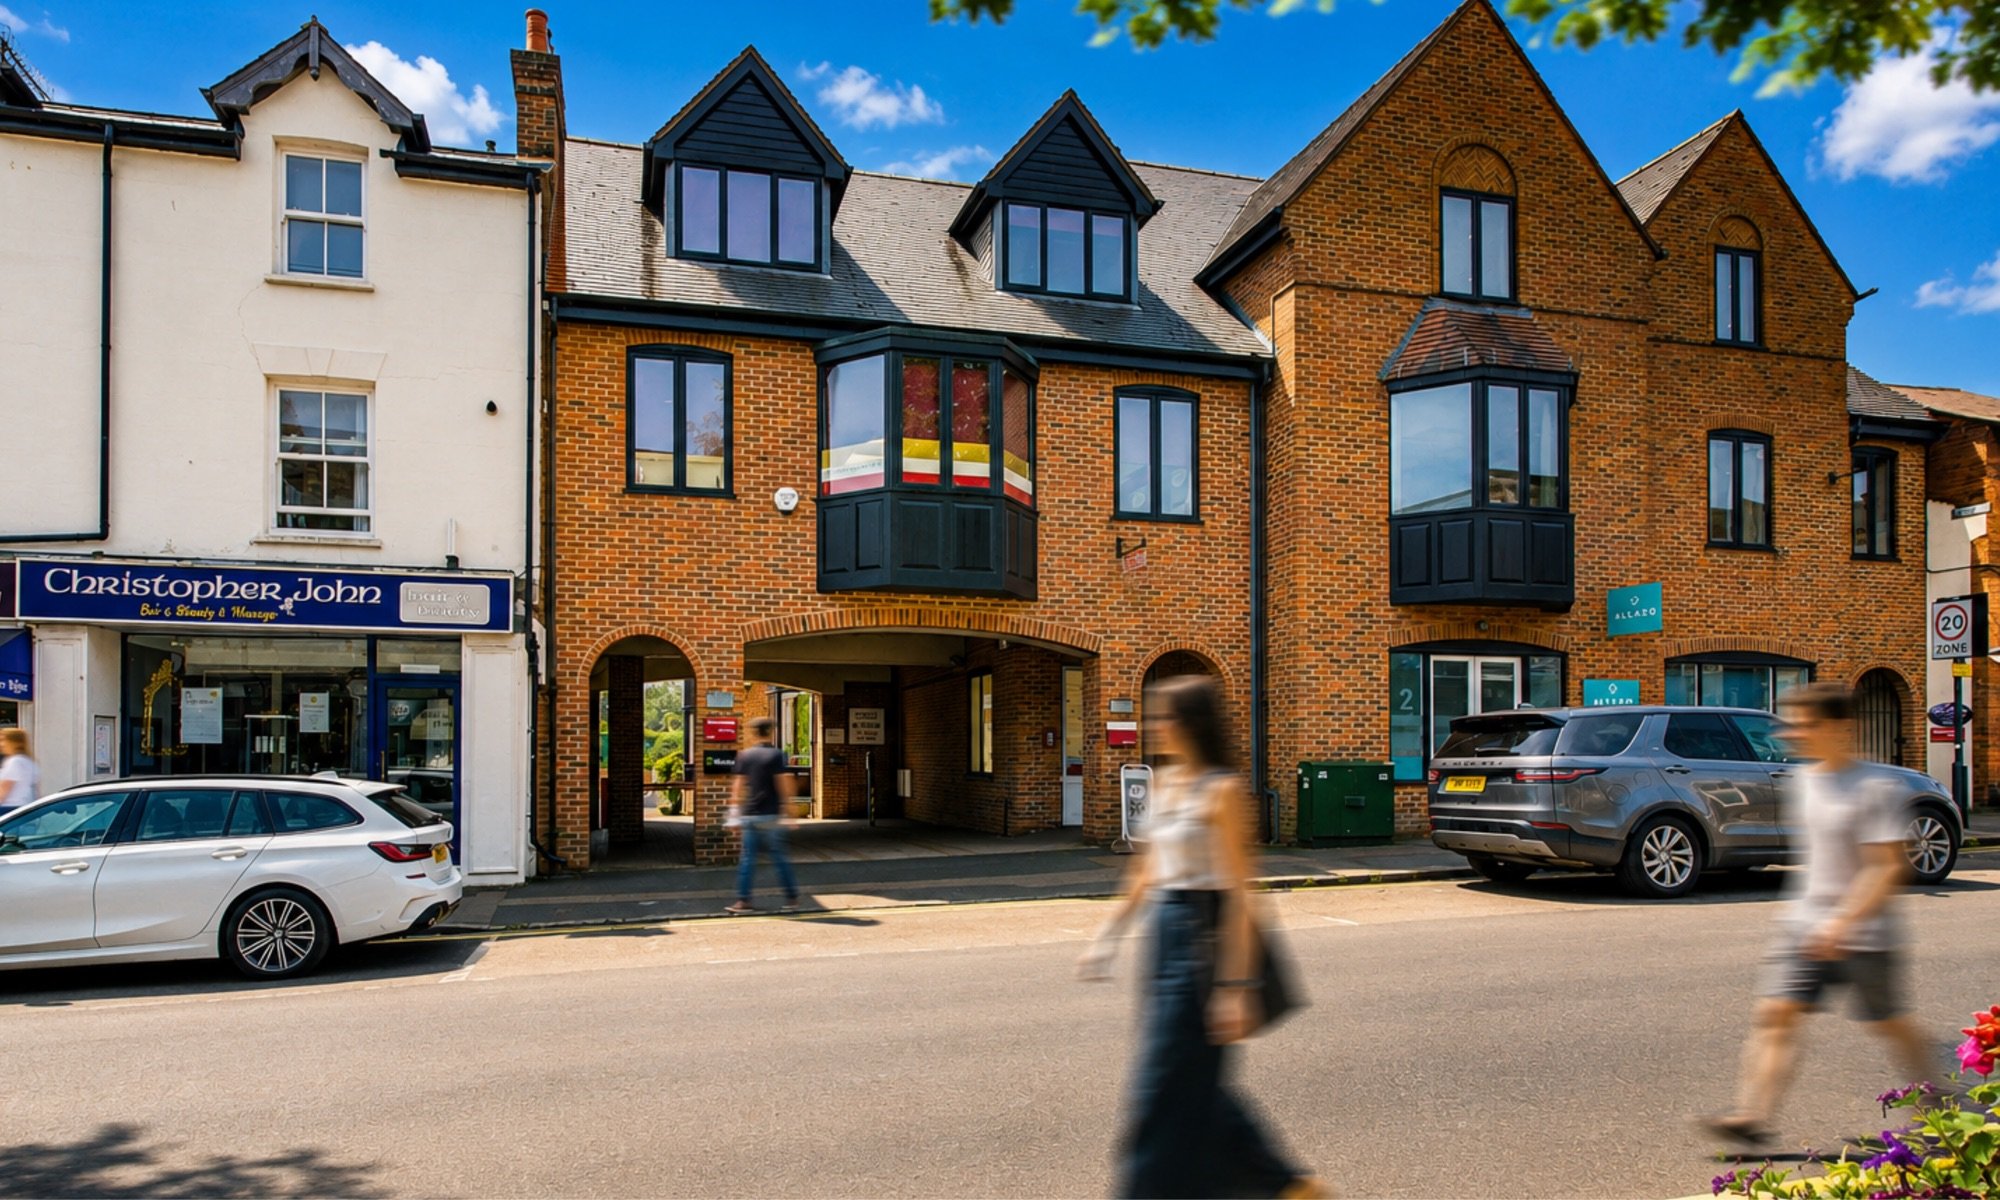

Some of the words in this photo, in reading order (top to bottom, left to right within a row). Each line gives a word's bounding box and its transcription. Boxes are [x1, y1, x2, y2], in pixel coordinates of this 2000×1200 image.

[44, 567, 282, 603] Christopher
[293, 577, 382, 604] John
[1941, 614, 1963, 631] 20
[1936, 643, 1968, 654] ZONE
[1399, 688, 1413, 710] 2
